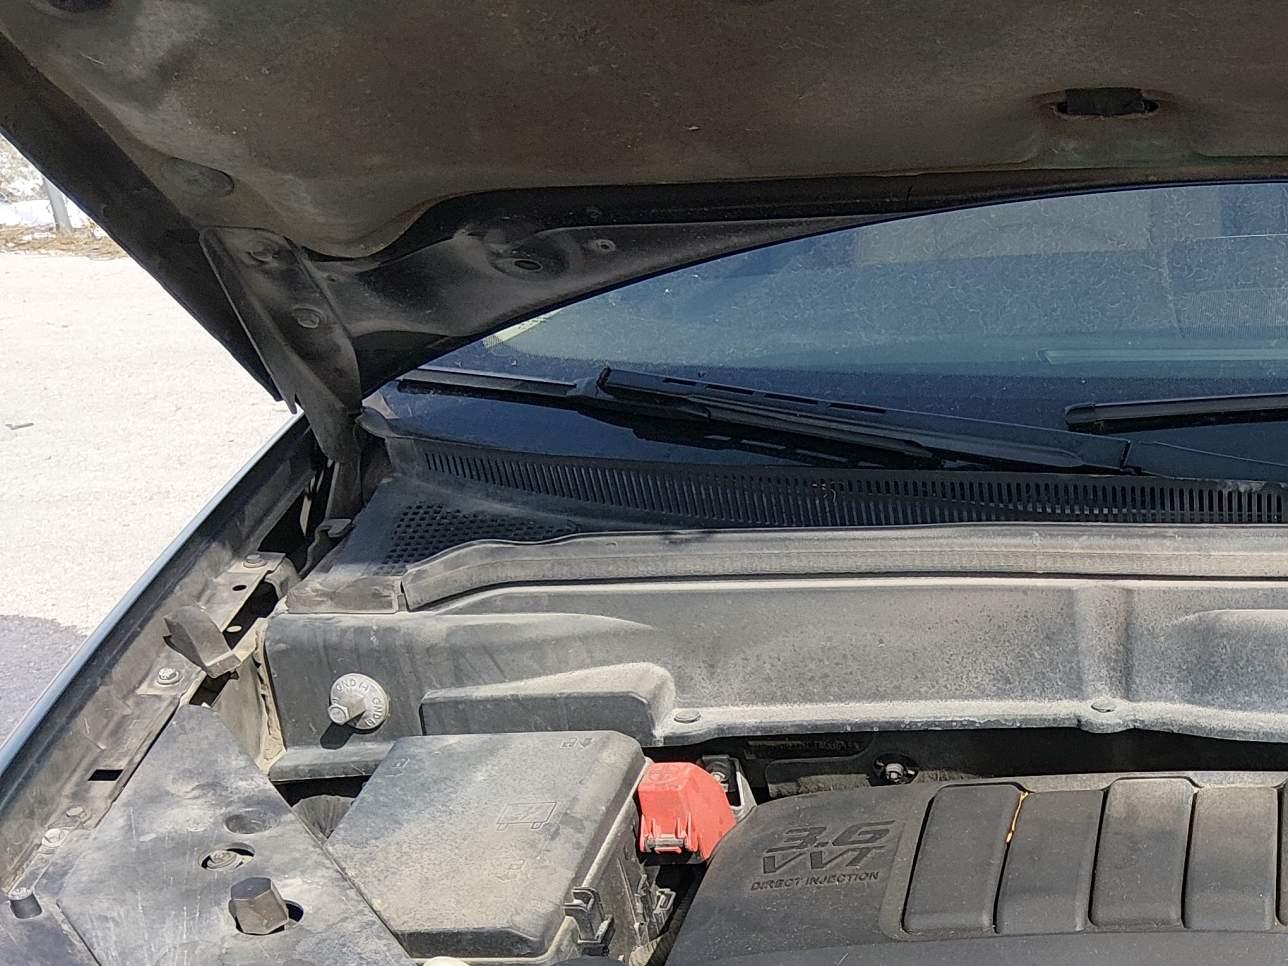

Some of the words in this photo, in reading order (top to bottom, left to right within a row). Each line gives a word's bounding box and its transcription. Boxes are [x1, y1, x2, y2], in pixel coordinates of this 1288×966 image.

[765, 820, 896, 853] 3.6
[762, 845, 888, 874] VVT
[751, 878, 803, 892] DIRECT
[804, 871, 880, 885] INJECTION
